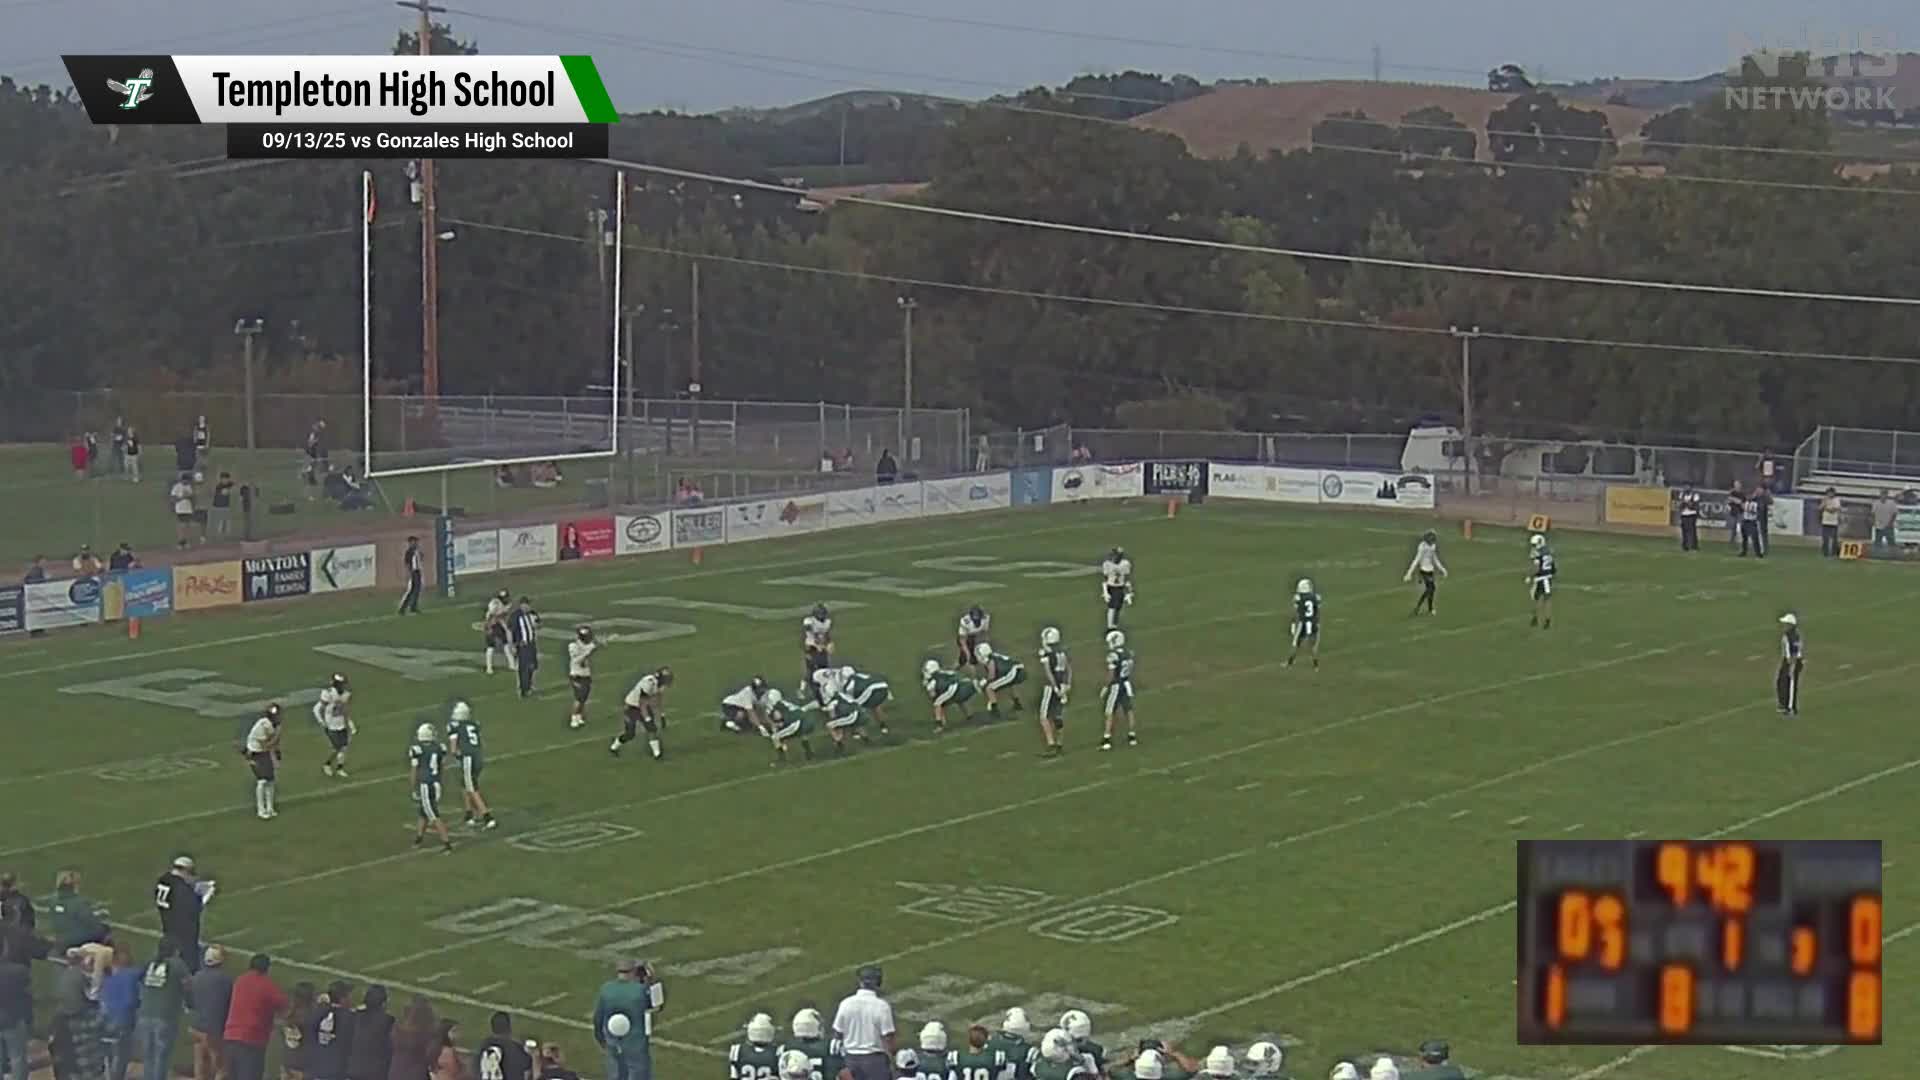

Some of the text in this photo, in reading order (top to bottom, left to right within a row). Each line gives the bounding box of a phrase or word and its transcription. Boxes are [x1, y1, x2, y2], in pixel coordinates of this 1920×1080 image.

[1532, 517, 1543, 529] G
[1843, 544, 1859, 556] 10
[244, 554, 307, 573] MONTOYA
[1304, 600, 1314, 617] 3
[467, 726, 479, 745] 5
[429, 753, 438, 775] 4
